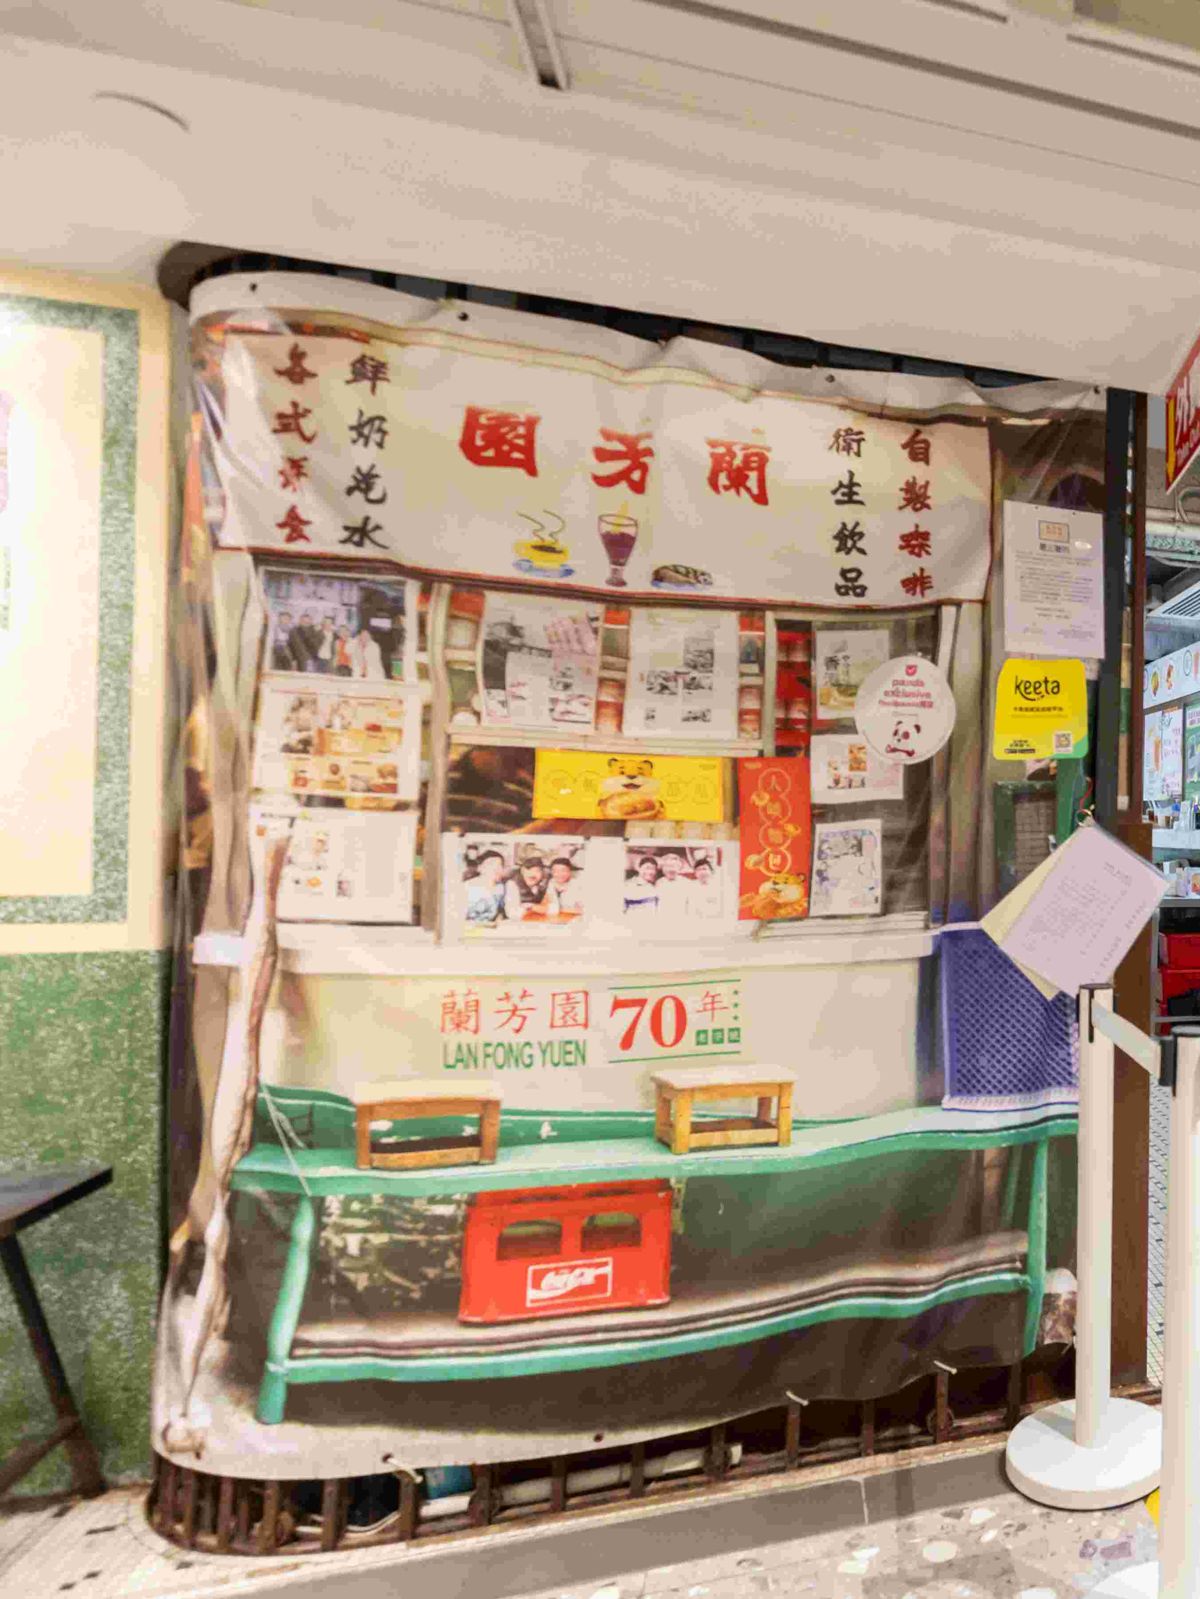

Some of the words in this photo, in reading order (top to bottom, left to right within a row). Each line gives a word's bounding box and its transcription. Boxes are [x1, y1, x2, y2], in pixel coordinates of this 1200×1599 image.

[828, 426, 869, 598] 衛生飲品
[1014, 675, 1061, 701] keeta
[440, 987, 590, 1035] 蘭芳園
[443, 1041, 479, 1069] LAN
[482, 1041, 534, 1068] FONG
[537, 1038, 587, 1067] YUEN
